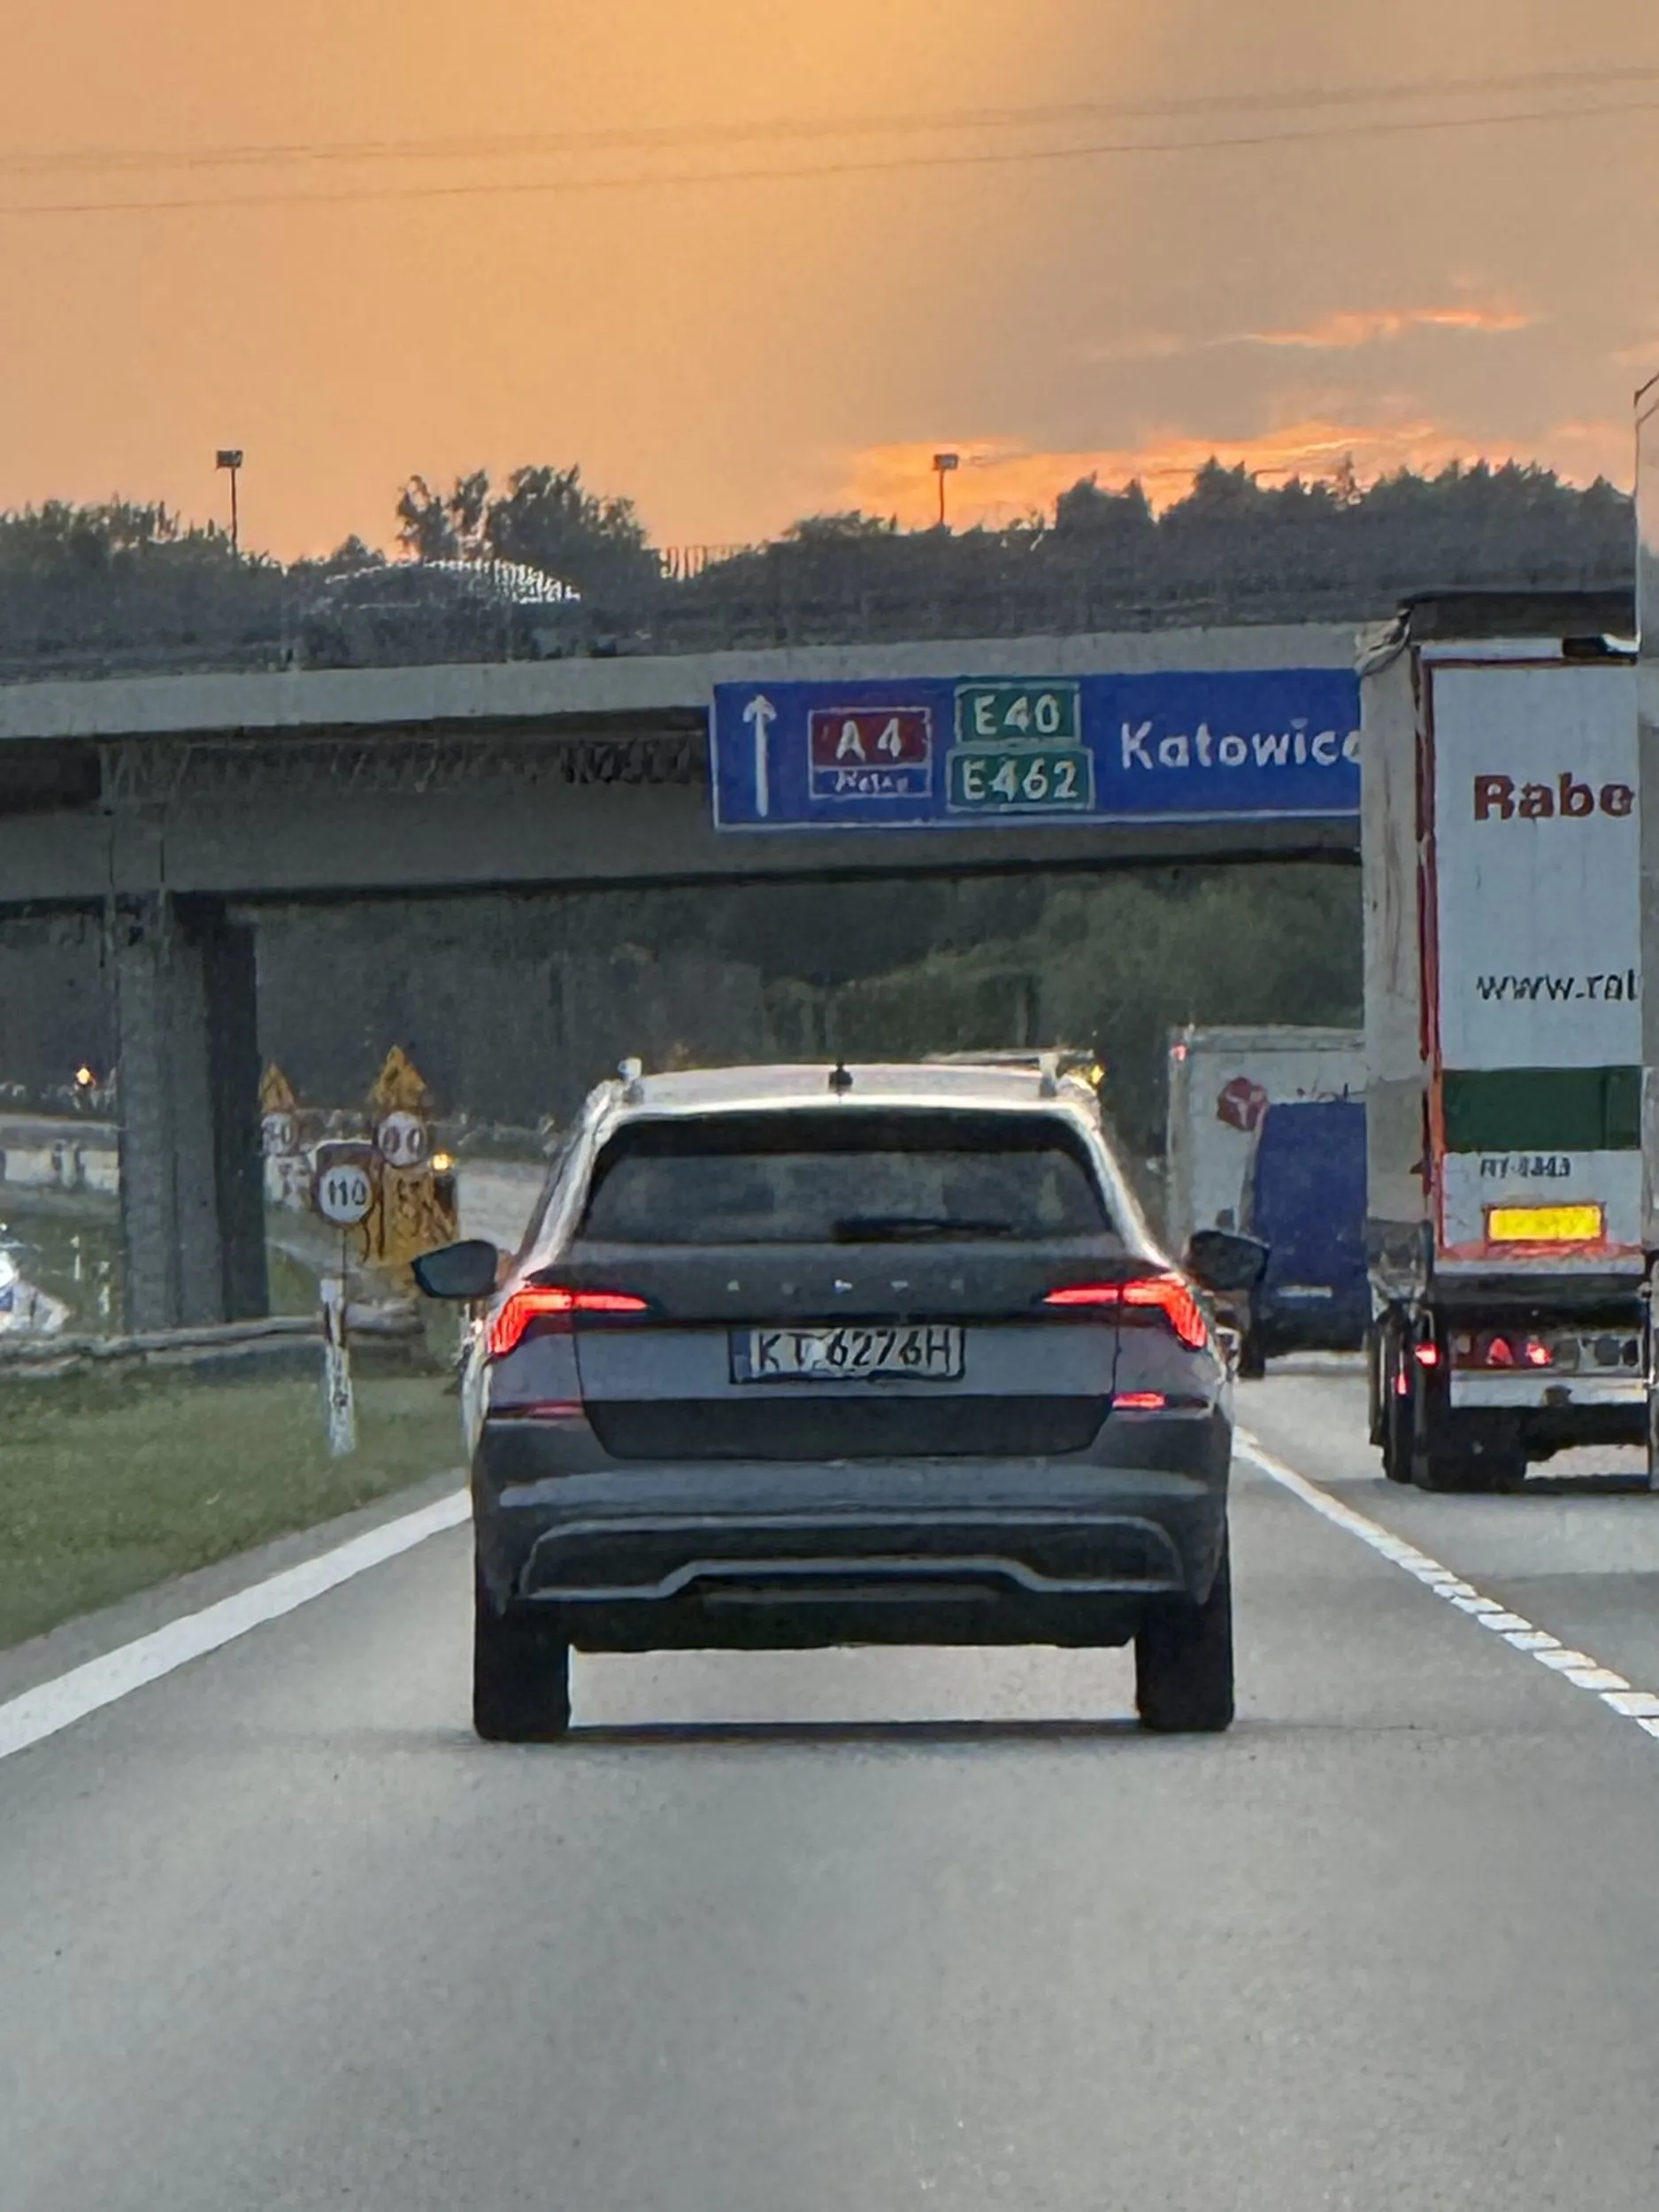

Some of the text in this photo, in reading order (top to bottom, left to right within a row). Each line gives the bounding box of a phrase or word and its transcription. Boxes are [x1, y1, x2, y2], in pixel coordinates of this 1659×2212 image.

[974, 693, 1060, 734] E40
[963, 758, 1079, 803] E462
[327, 1179, 367, 1206] 110
